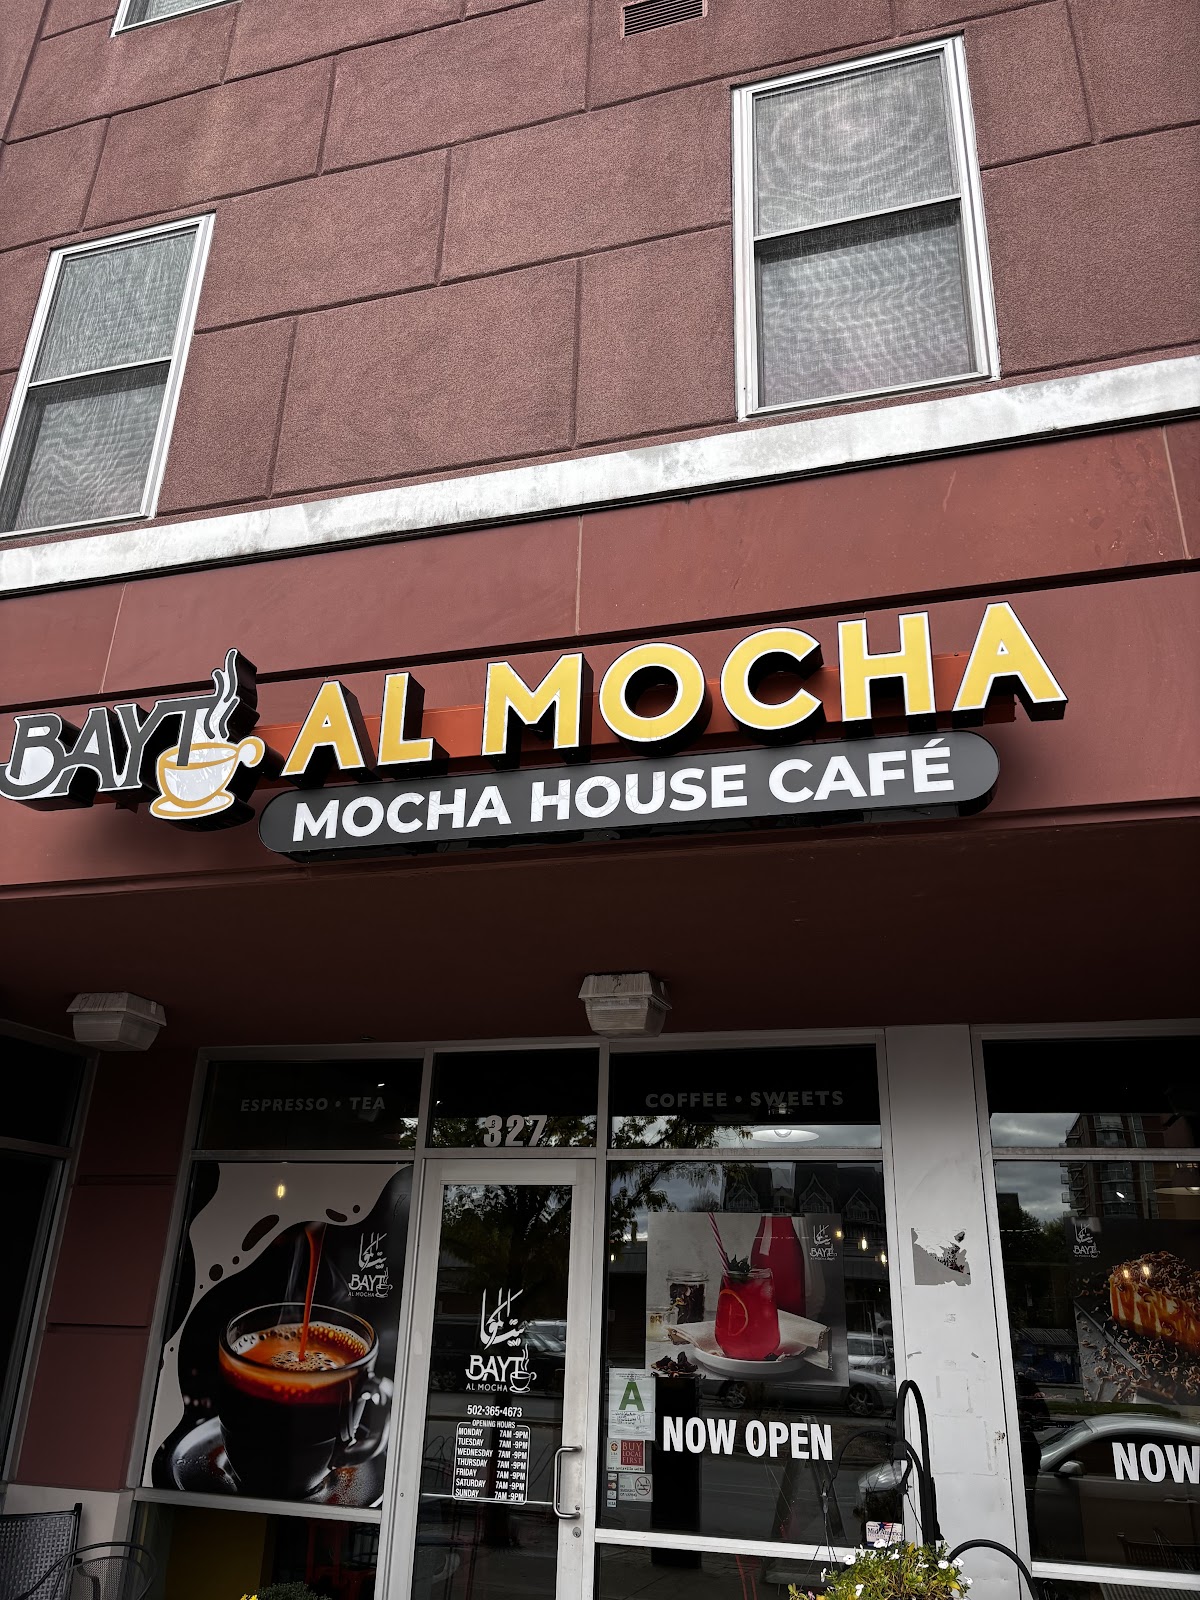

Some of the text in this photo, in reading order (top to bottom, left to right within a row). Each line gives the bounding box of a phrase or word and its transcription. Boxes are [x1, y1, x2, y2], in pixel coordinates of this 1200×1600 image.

[0, 601, 1069, 798] BAYT AL MOCHA
[292, 737, 956, 842] MOCHA HOUSE CAFÉ
[240, 1096, 386, 1112] ESPRESSO TEA
[645, 1090, 844, 1108] COFFEE SWEETS
[483, 1114, 548, 1147] 327
[348, 1274, 386, 1291] BAYT
[465, 1354, 526, 1382] BAYT
[466, 1383, 508, 1392] AL MOCHA
[618, 1381, 646, 1412] A
[472, 1419, 516, 1429] OPENING HOURS
[458, 1428, 483, 1437] MONDAY
[499, 1430, 512, 1438] 7AM
[663, 1416, 833, 1461] NOW OPEN
[457, 1438, 484, 1447] TUESDAY
[499, 1440, 511, 1448] 7AM
[622, 1441, 642, 1450] BUY
[457, 1448, 493, 1457] WEDNESDAY
[498, 1450, 510, 1458] 7AM
[457, 1458, 488, 1467] THURSDAY
[497, 1460, 509, 1468] 7AM
[1111, 1442, 1200, 1484] NOW
[456, 1468, 477, 1477] FRIDAY
[496, 1470, 509, 1479] 7AM
[455, 1478, 486, 1487] SATURDAY
[495, 1481, 508, 1489] 7AM
[455, 1488, 479, 1498] SUNDAY
[494, 1491, 507, 1500] 7AM
